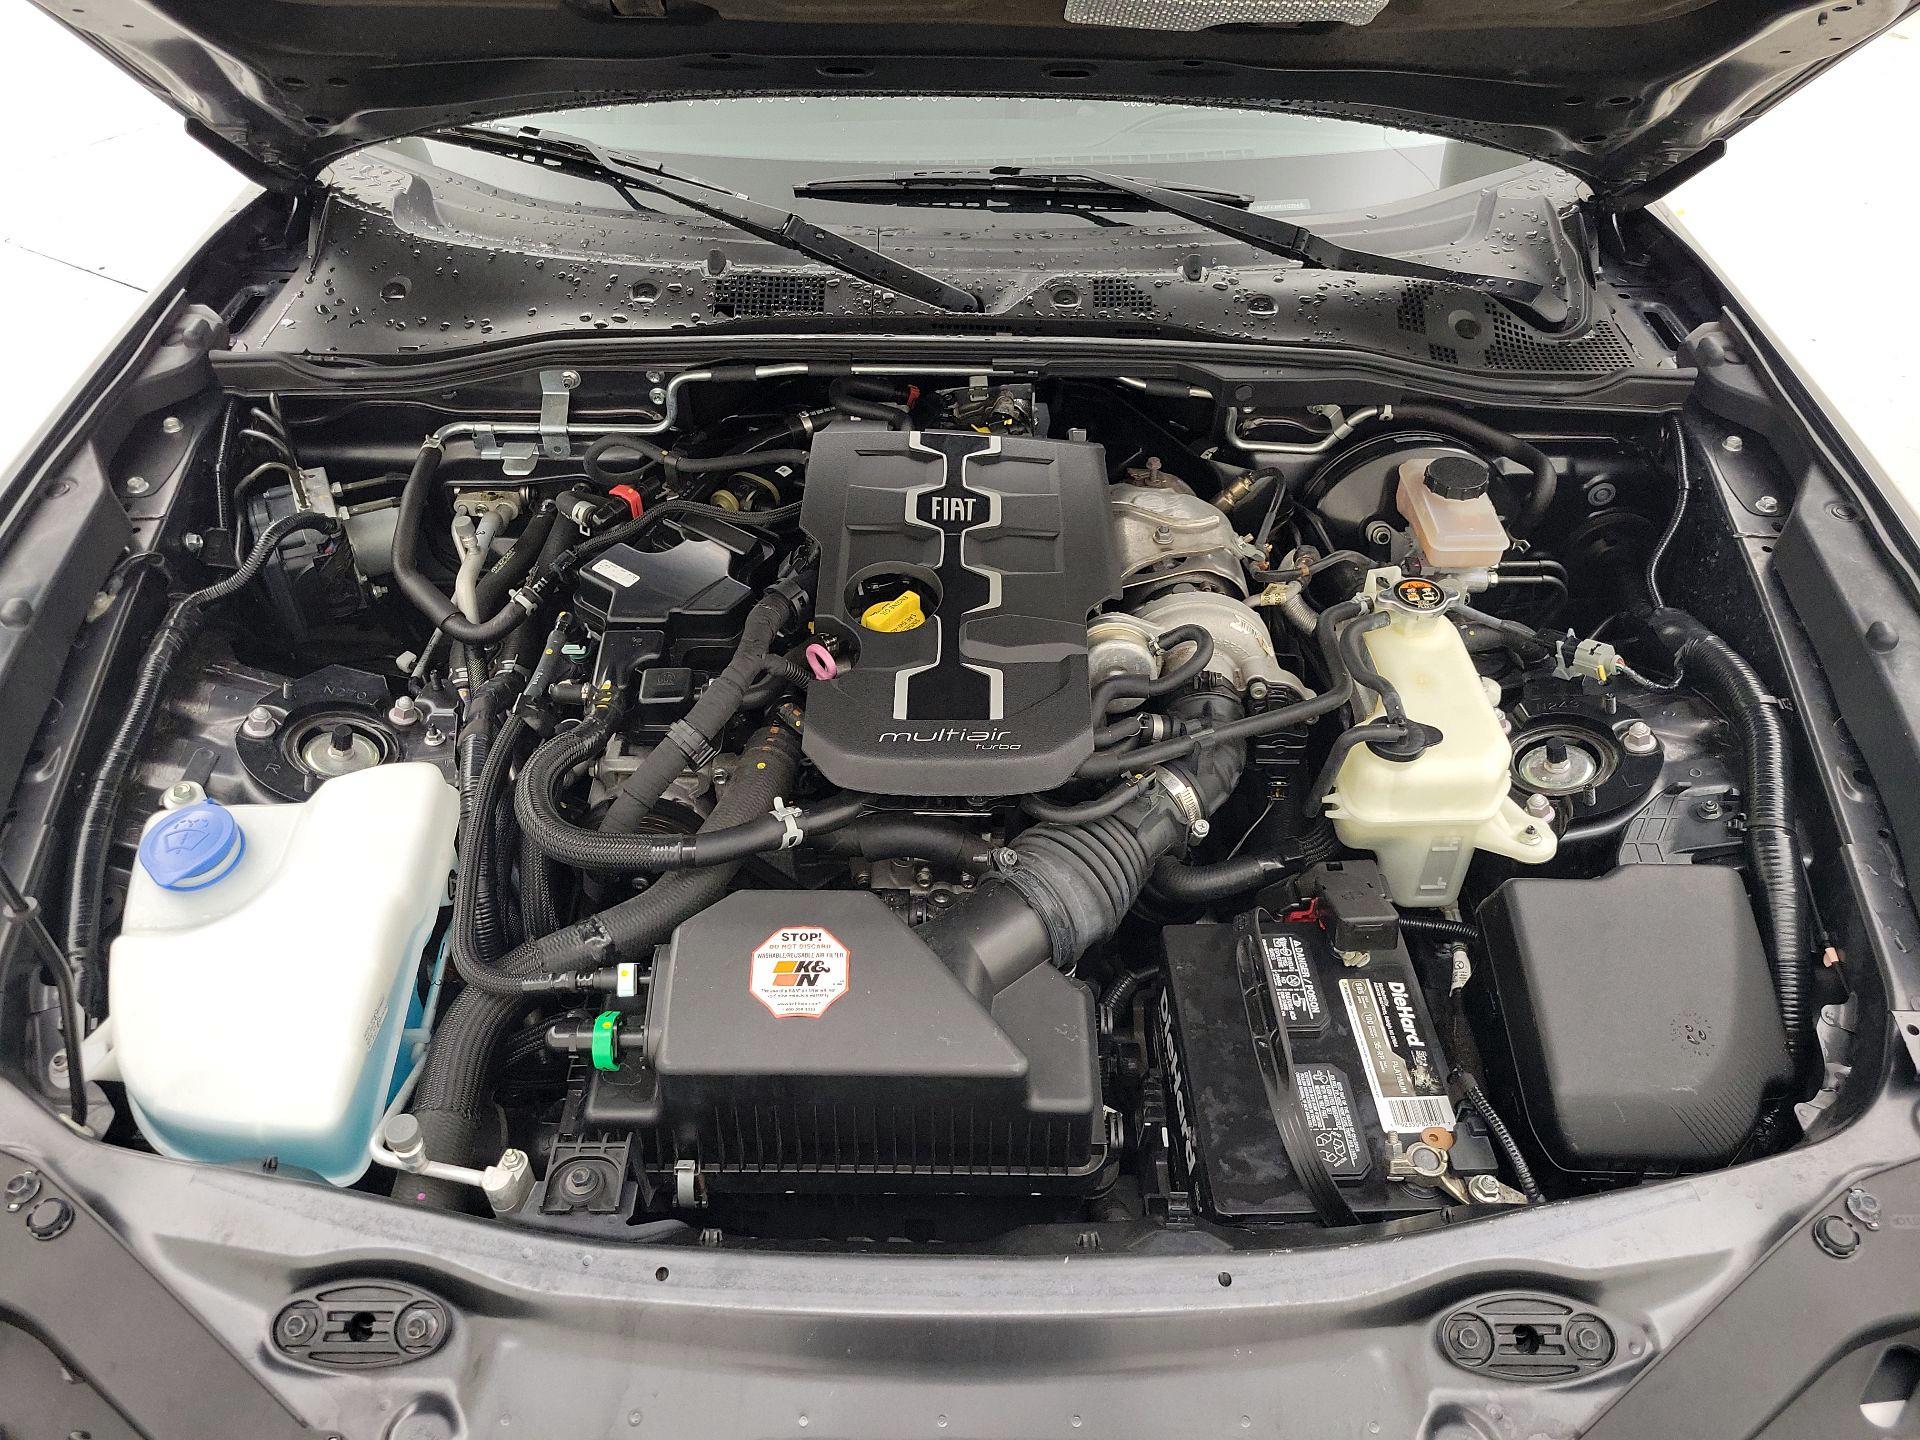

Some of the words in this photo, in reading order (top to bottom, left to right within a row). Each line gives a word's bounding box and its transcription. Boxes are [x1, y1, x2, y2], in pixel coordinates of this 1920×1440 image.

[931, 496, 976, 521] FIAT
[878, 727, 1011, 742] multiair
[781, 932, 822, 942] STOP!
[1294, 946, 1310, 977] DANGER
[1304, 984, 1320, 1013] POISON
[1364, 1012, 1374, 1024] 100
[1387, 981, 1425, 1047] DieHard
[1160, 985, 1196, 1176] DieHard
[1391, 1060, 1407, 1094] PLATINUM
